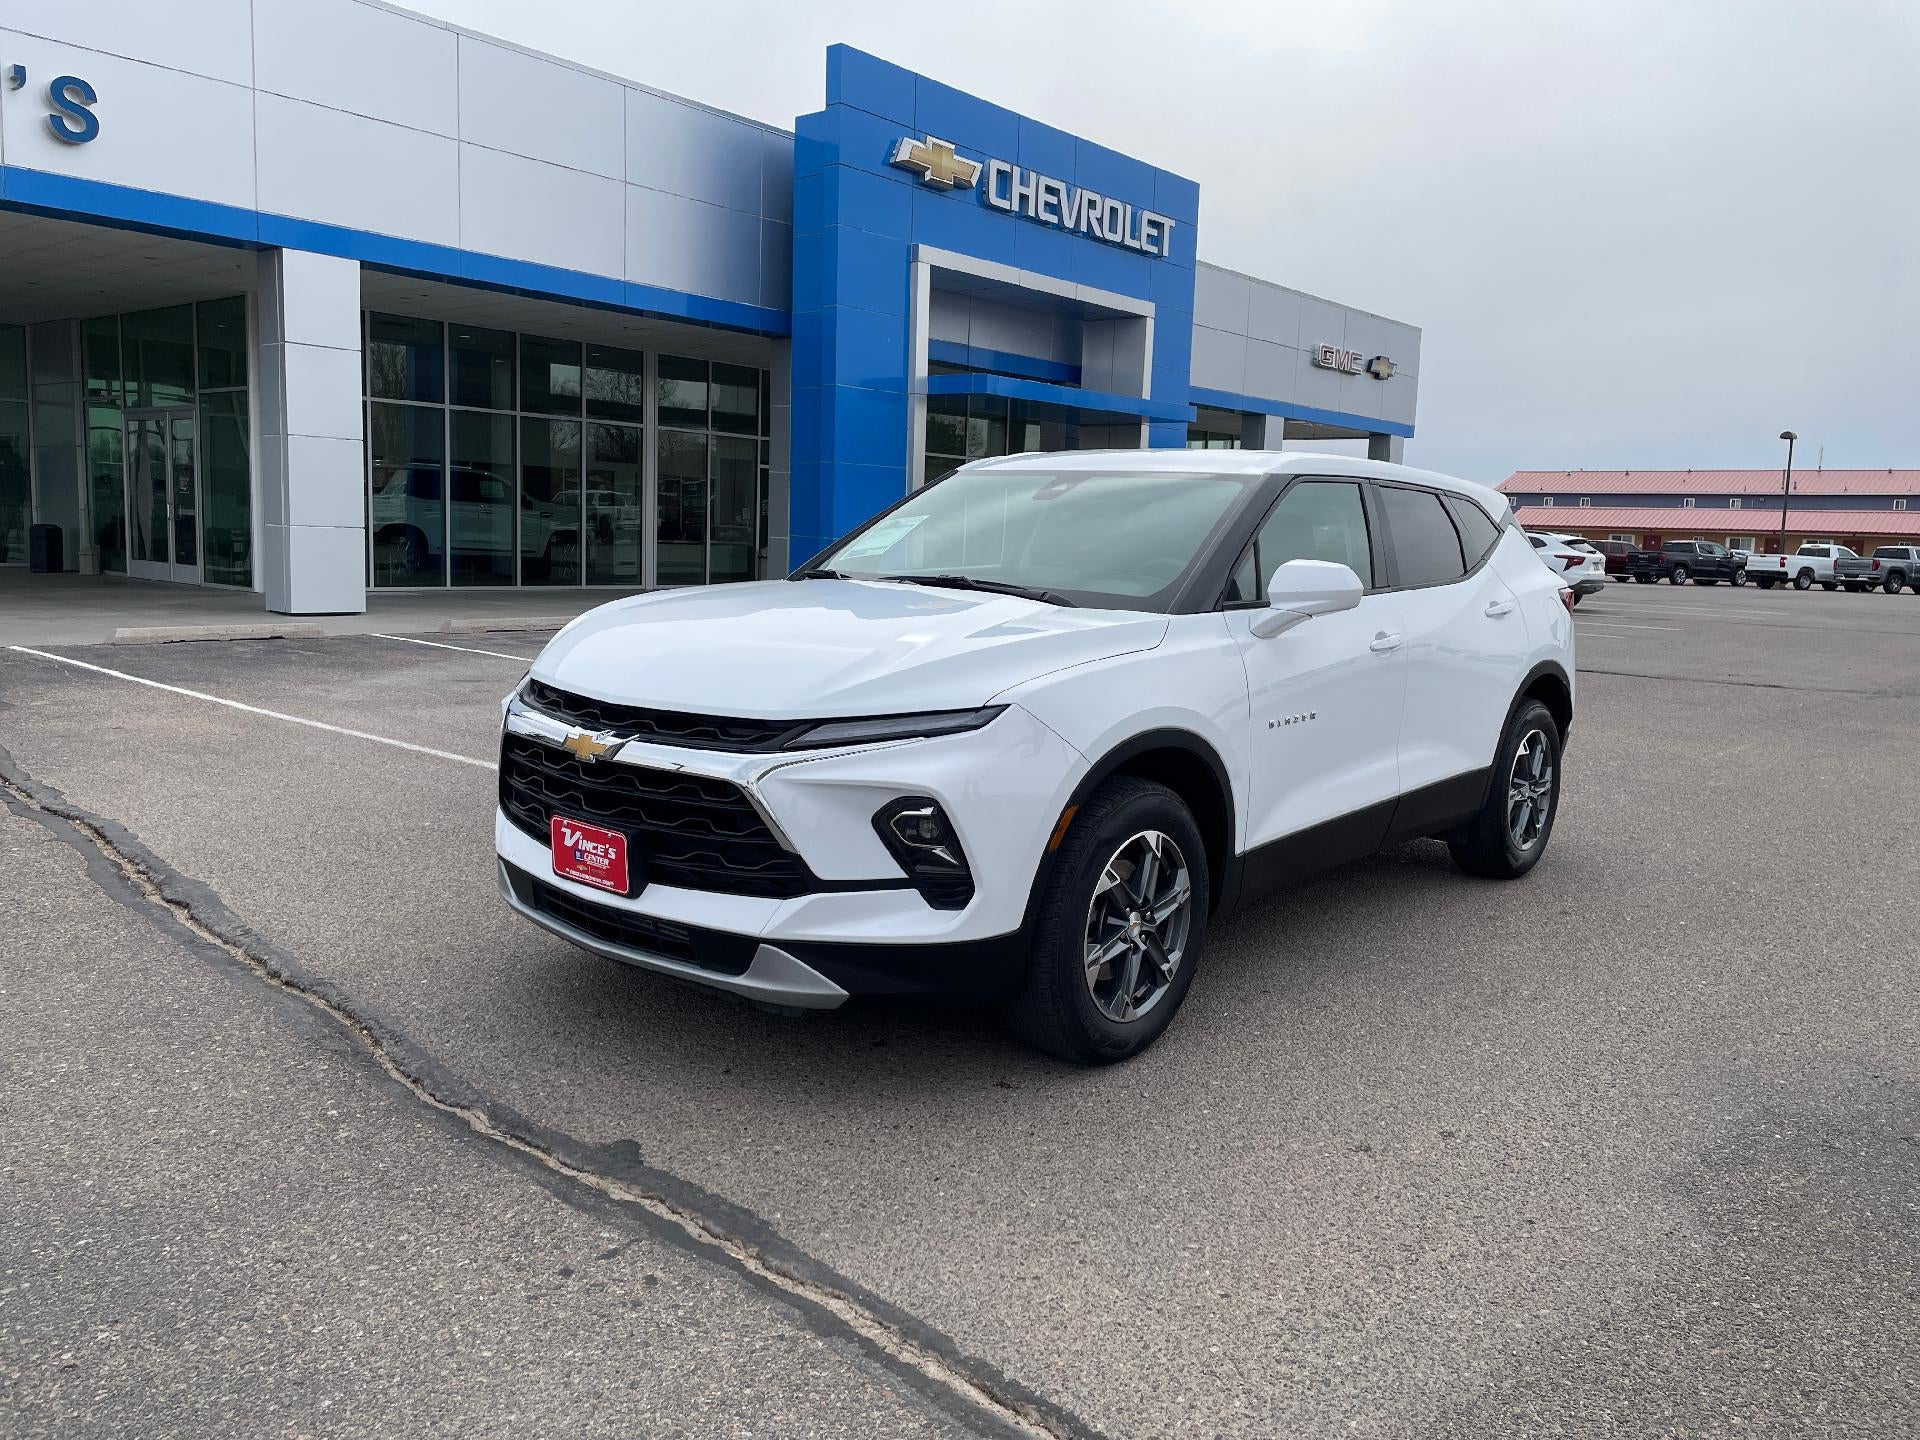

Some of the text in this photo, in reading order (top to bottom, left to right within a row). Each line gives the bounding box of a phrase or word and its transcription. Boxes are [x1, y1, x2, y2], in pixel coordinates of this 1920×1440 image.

[982, 158, 1176, 257] CHEVROLET
[1319, 343, 1363, 374] GMC
[1268, 712, 1317, 729] BLAZER
[584, 852, 610, 866] CENTER
